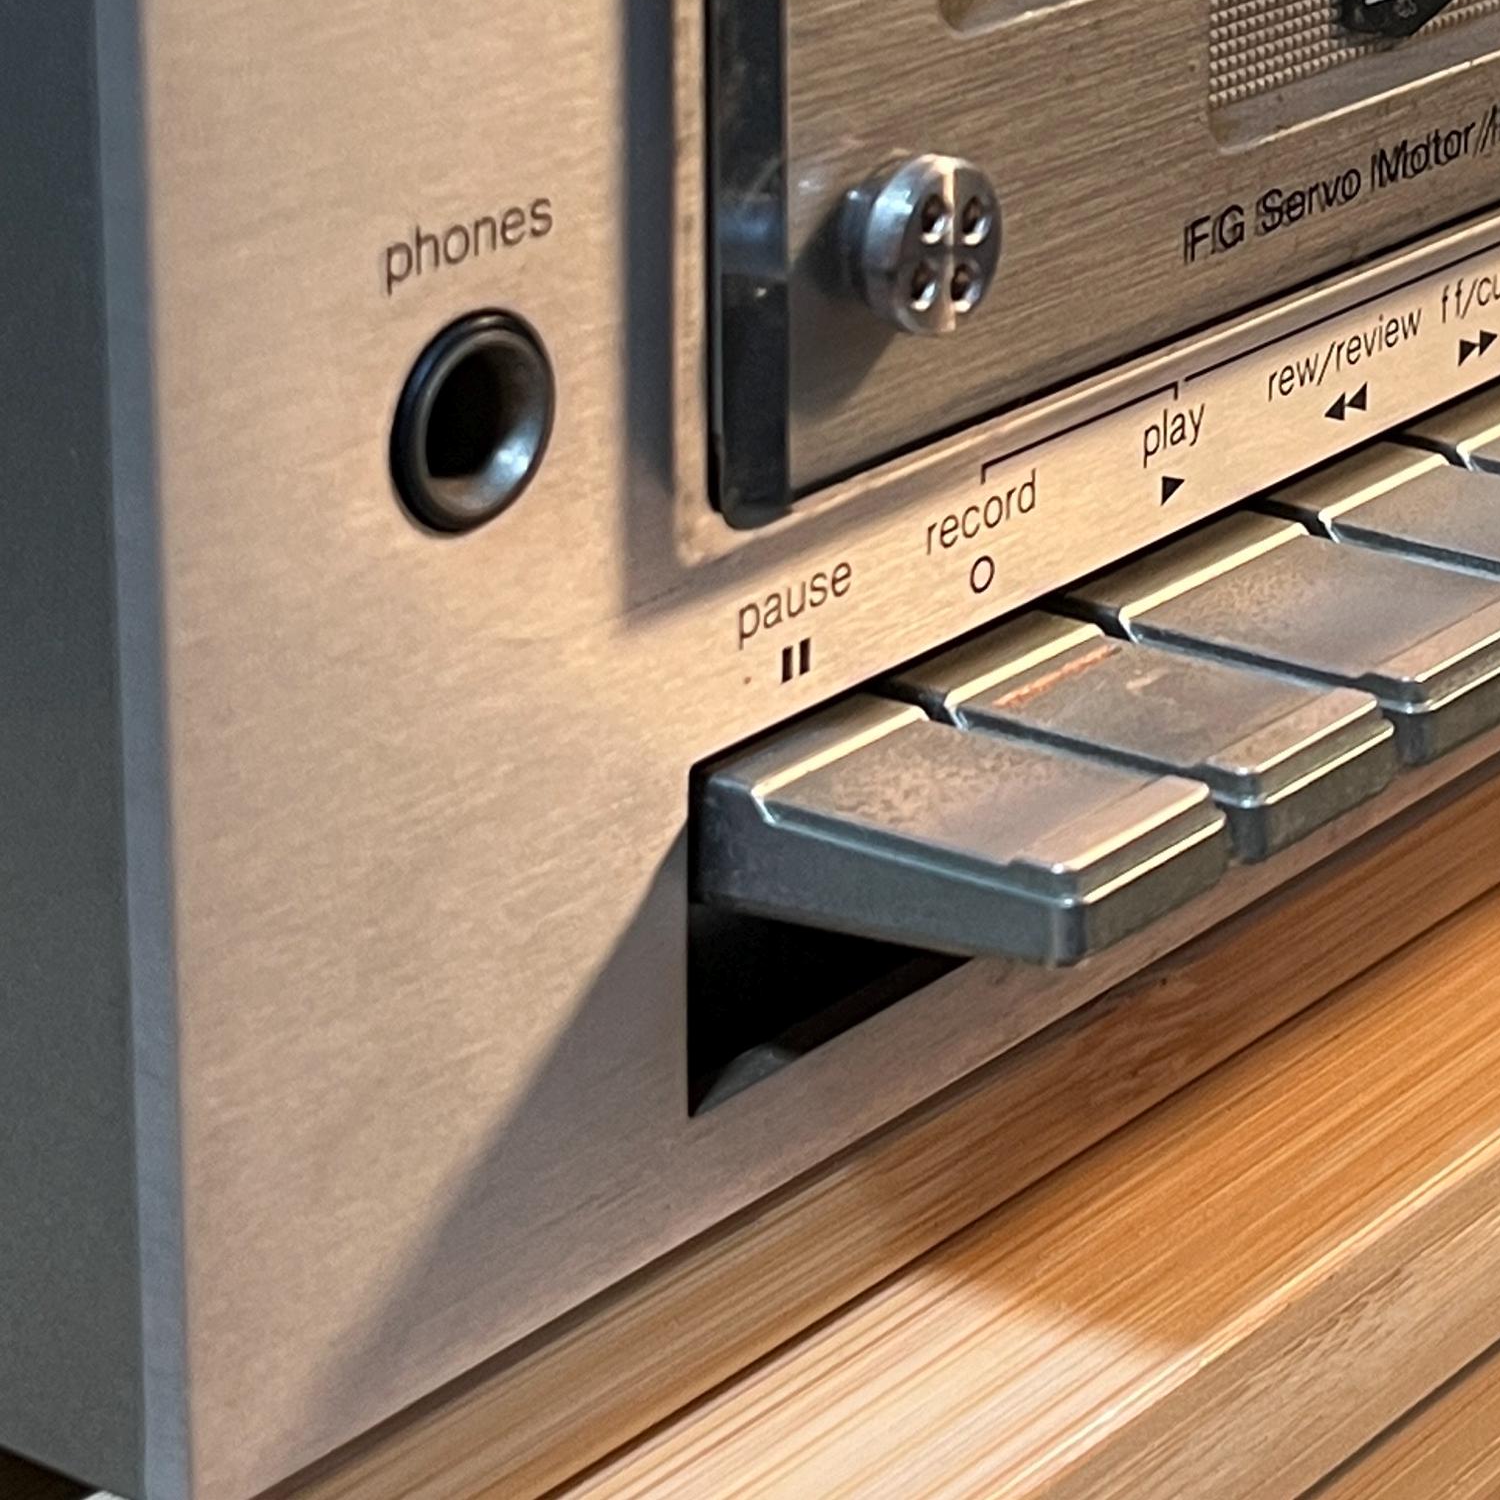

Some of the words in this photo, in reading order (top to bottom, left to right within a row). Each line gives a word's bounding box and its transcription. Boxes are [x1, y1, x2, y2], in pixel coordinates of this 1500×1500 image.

[386, 198, 553, 296] phones
[1186, 204, 1245, 262] FG
[1257, 168, 1361, 234] Servo
[1267, 308, 1422, 402] rew/review
[1143, 403, 1205, 468] play
[926, 468, 1037, 556] record
[737, 562, 853, 649] pause
